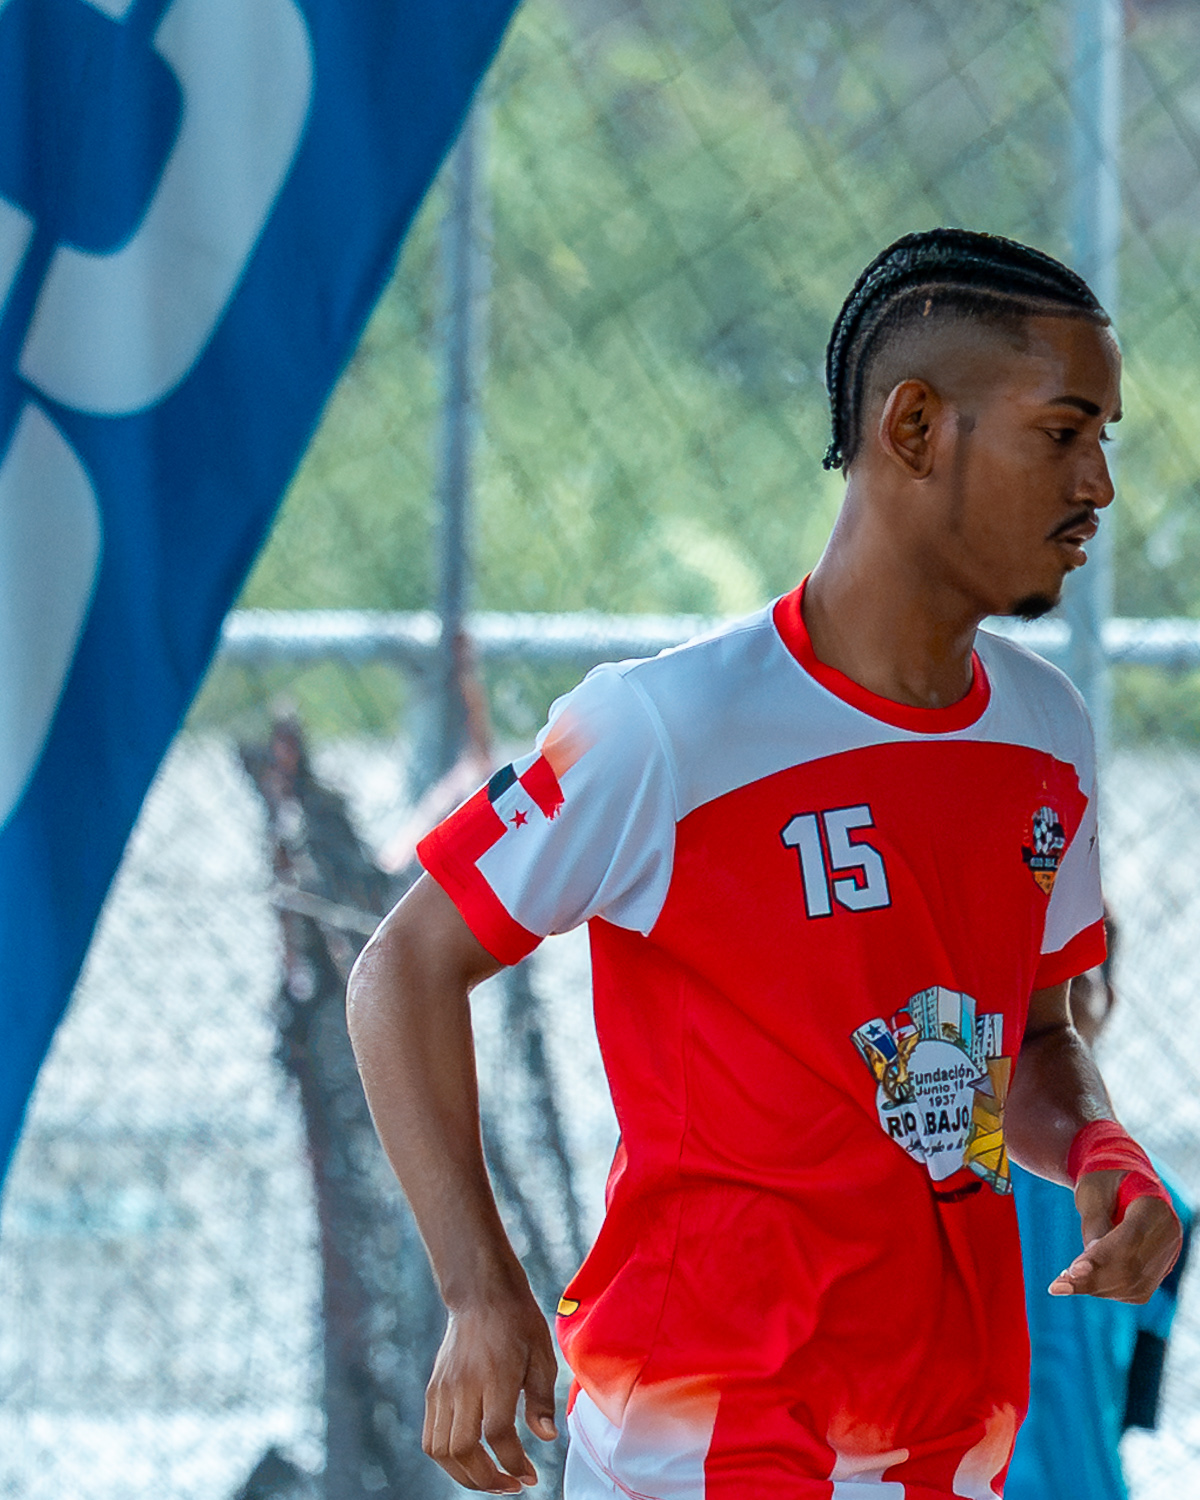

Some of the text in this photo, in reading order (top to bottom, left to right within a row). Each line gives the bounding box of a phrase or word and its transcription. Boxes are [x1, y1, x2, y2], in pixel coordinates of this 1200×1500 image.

[780, 803, 892, 920] 15
[908, 1063, 975, 1085] Fundación
[916, 1084, 951, 1096] Junio
[929, 1094, 956, 1107] 1937
